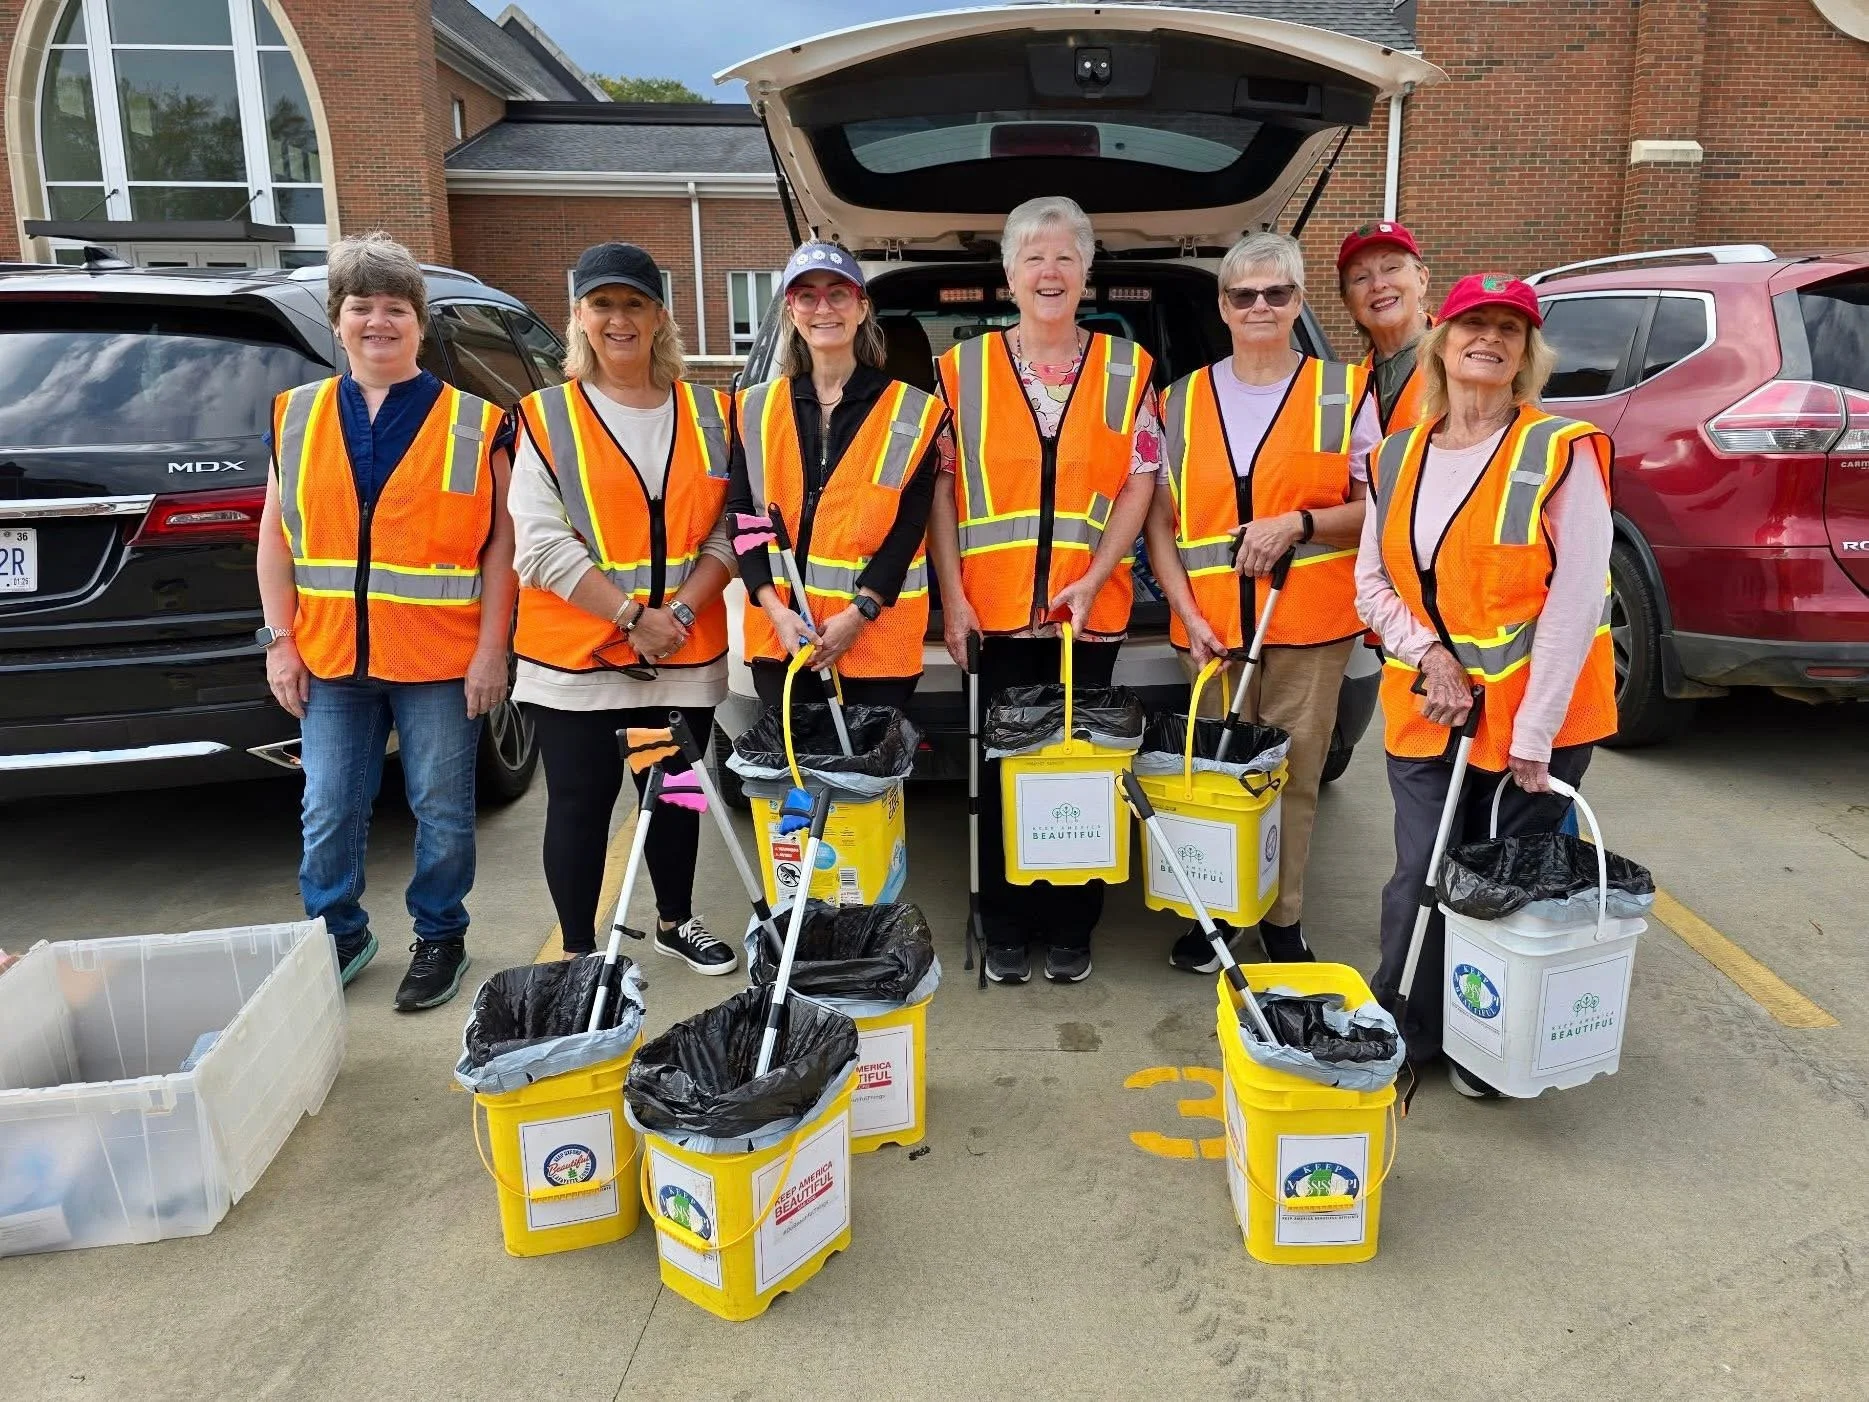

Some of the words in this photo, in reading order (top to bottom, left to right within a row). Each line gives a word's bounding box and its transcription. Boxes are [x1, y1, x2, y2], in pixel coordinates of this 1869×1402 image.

[168, 461, 246, 473] MDX
[16, 532, 28, 541] 36
[1033, 831, 1101, 839] BEAUTIFUL
[1160, 864, 1223, 884] BETIFUL
[1551, 1017, 1613, 1041] BEAUTIFUL
[856, 1062, 891, 1073] MERICA
[859, 1071, 892, 1083] TIFUL
[1123, 1066, 1227, 1161] 3
[548, 1153, 590, 1175] Beautiful
[1303, 1163, 1342, 1174] KEEP
[775, 1186, 797, 1207] KEEP
[798, 1160, 833, 1191] AMERICA
[775, 1171, 833, 1219] BEAUTIFUL
